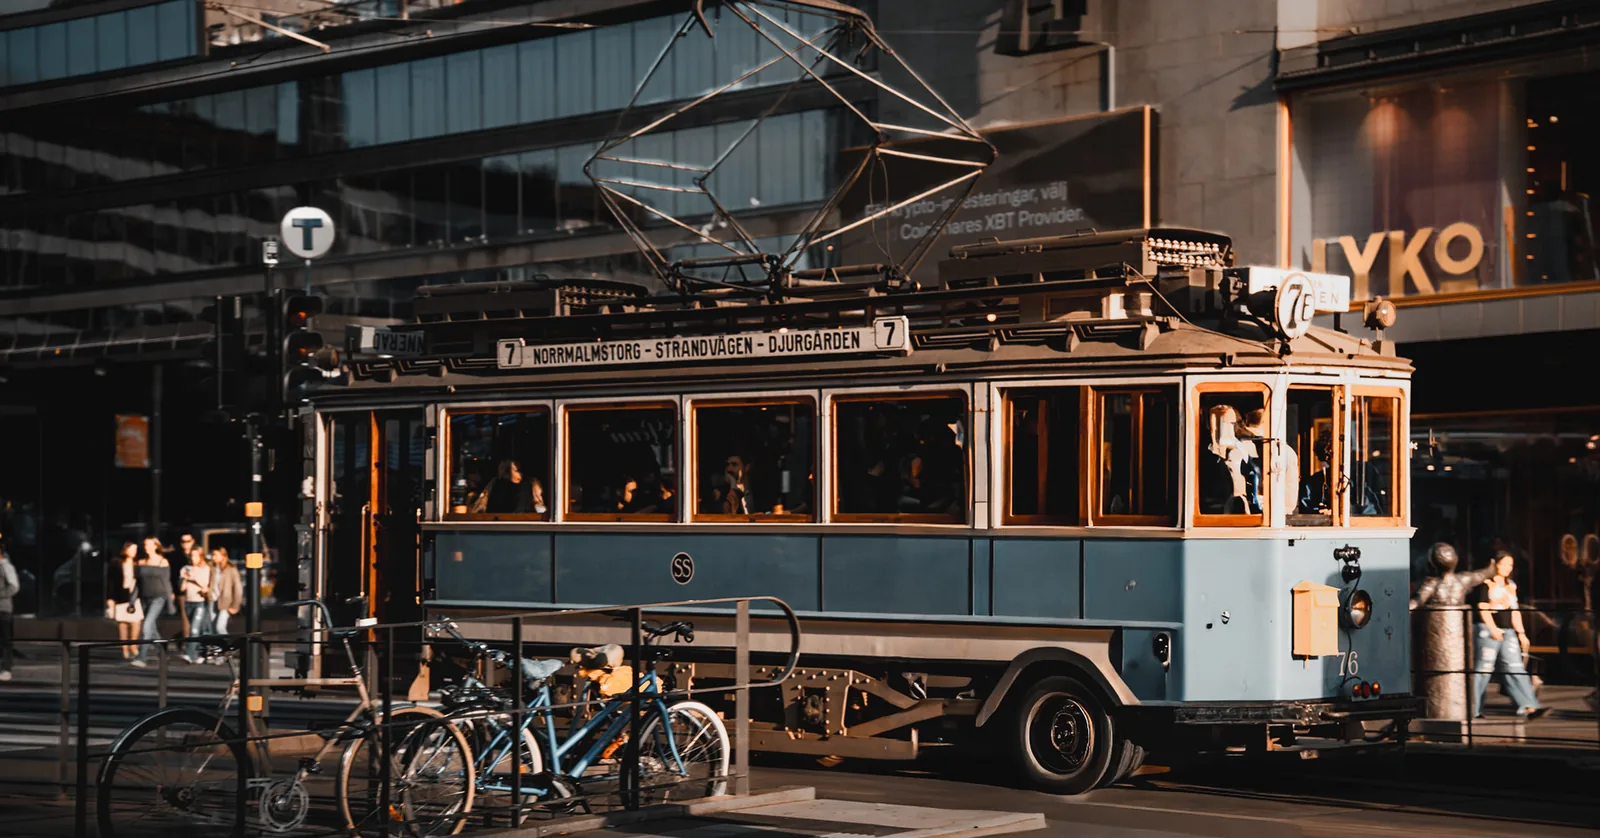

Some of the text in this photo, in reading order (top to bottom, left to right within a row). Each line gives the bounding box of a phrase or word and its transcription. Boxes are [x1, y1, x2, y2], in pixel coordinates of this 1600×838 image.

[890, 188, 1039, 219] krypto-inesteringar,
[1040, 180, 1067, 201] välj
[292, 218, 323, 250] T
[900, 206, 1084, 239] Coinhares XBT Provider.
[505, 343, 515, 365] 7
[533, 343, 641, 365] NORRMALMSTORG
[655, 336, 753, 359] STRANDVÄGEN
[768, 331, 860, 353] DJURGÅRDEN
[883, 321, 895, 346] 7
[674, 558, 691, 578] SS
[1337, 651, 1359, 676] 76
